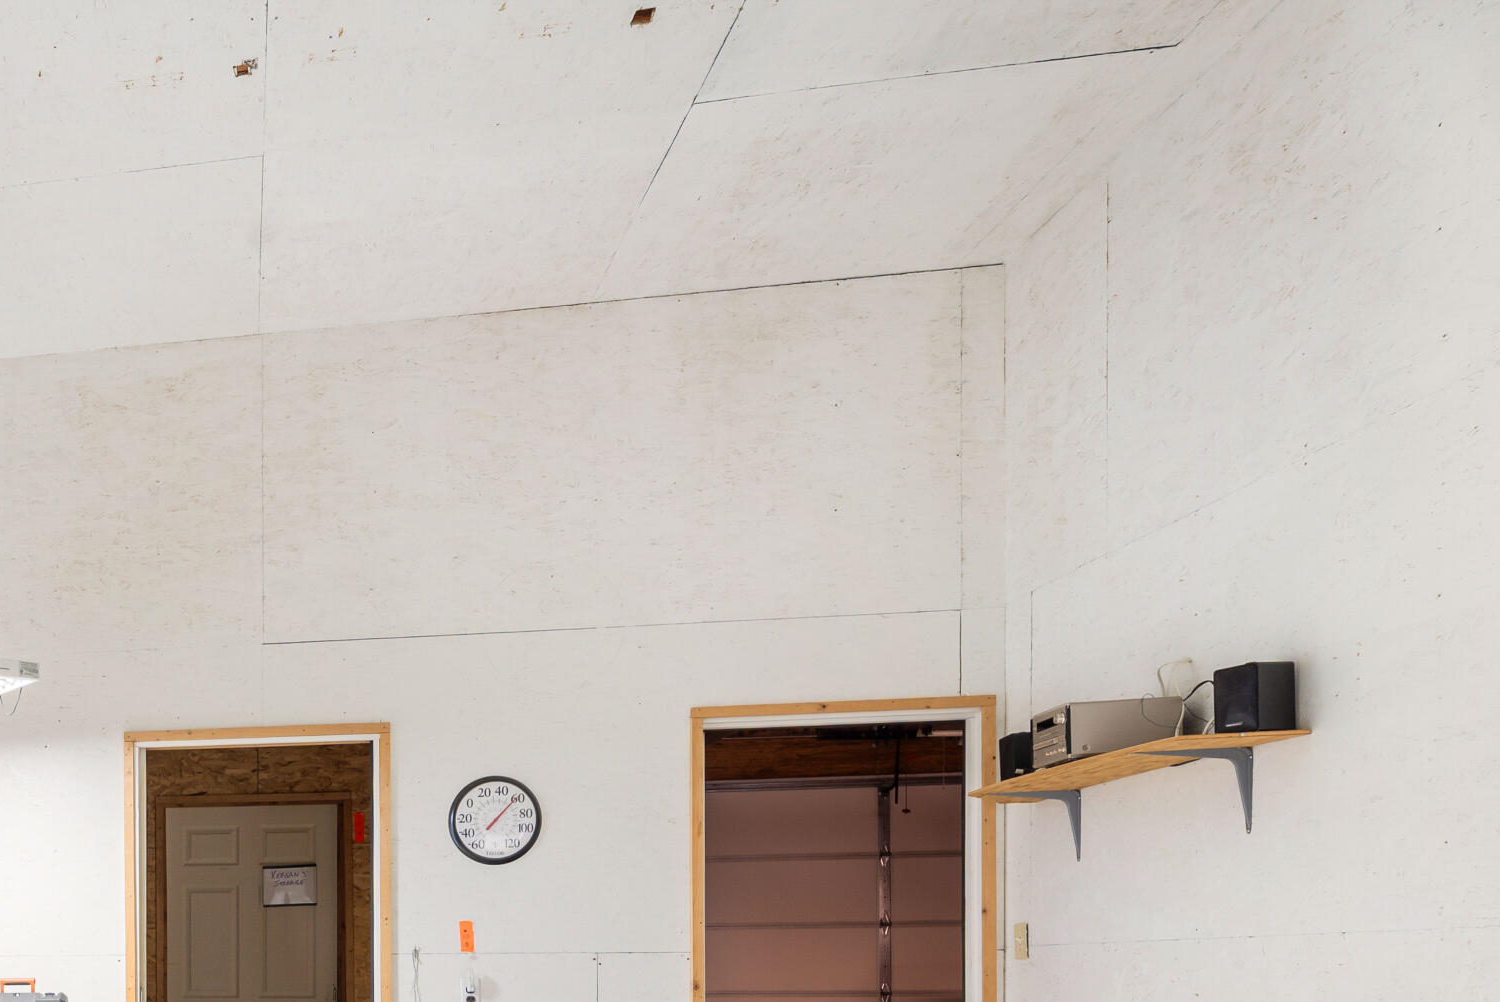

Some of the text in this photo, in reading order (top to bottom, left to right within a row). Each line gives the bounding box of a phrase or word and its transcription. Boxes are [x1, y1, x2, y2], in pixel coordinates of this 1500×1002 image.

[477, 788, 491, 797] 20
[495, 786, 508, 796] 40
[511, 793, 525, 803] 60
[466, 799, 474, 808] 0
[519, 809, 533, 818] 80
[518, 824, 534, 833] 100
[505, 839, 520, 848] 120
